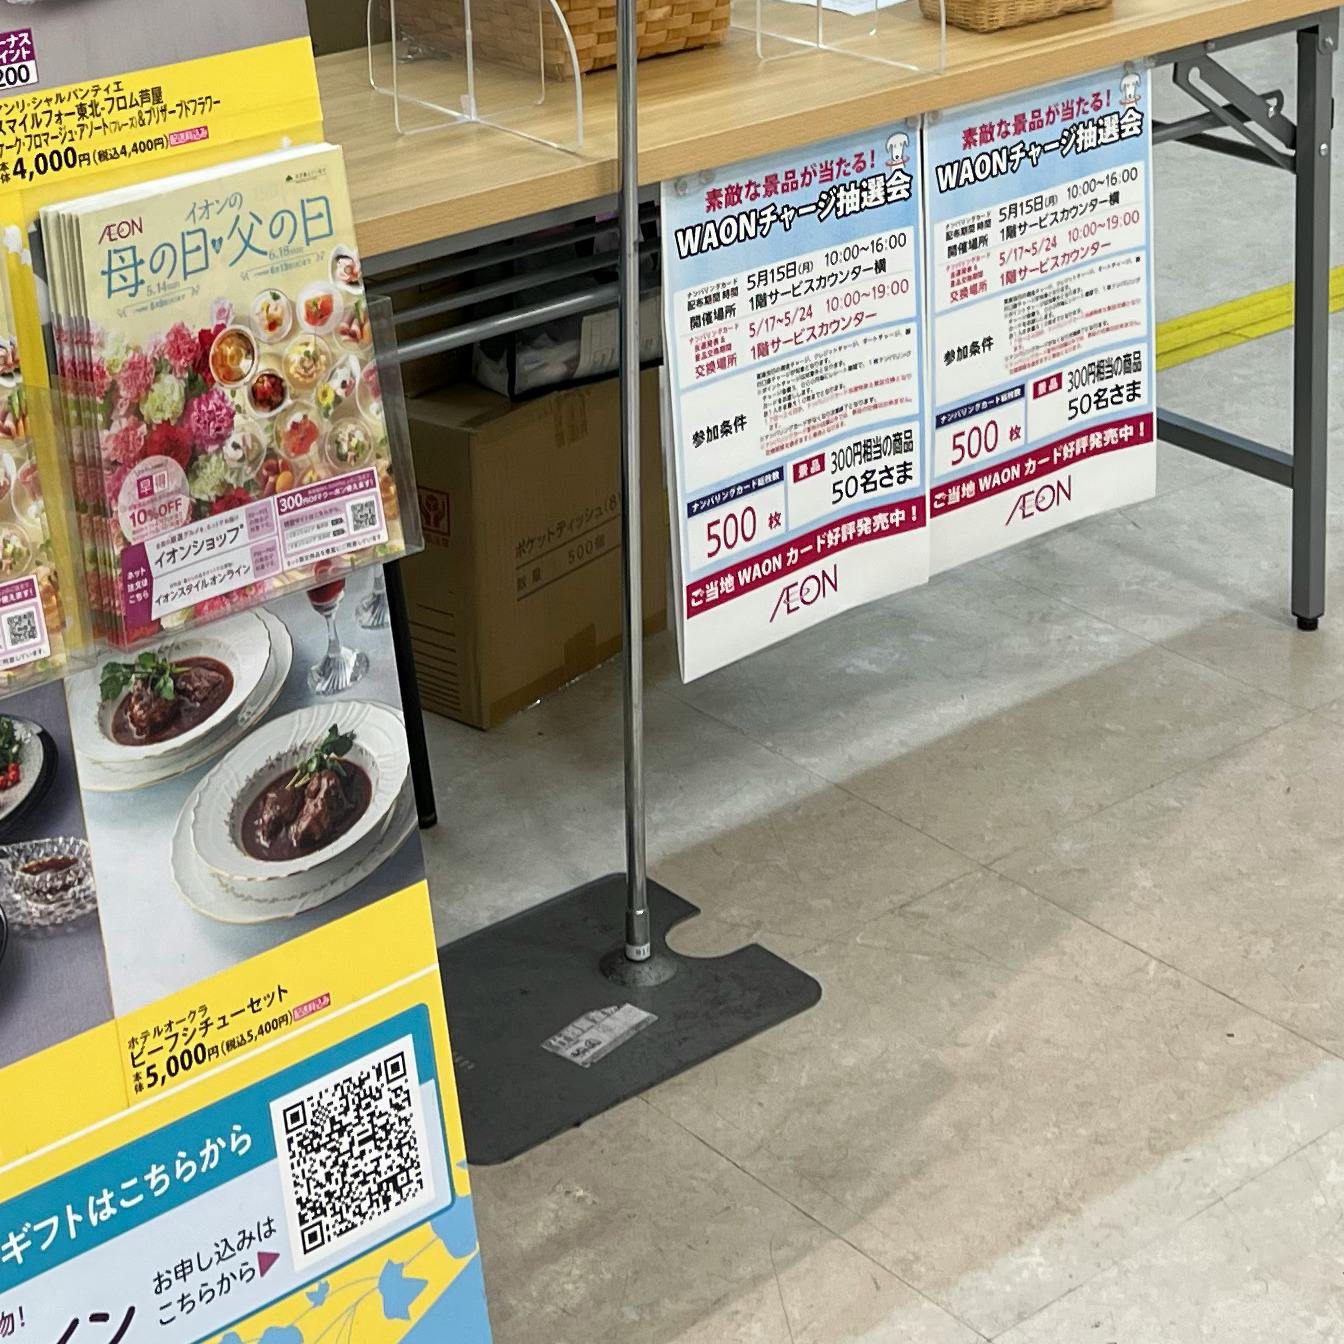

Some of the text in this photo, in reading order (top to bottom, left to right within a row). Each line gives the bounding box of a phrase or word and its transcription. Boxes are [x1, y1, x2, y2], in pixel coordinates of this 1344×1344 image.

[936, 107, 1144, 193] WAONチャージ抽選会
[185, 192, 243, 224] イオンの
[675, 168, 913, 259] WAONチャージ抽選会
[999, 195, 1058, 222] 5月15日(月)
[1000, 191, 1120, 242] 1階サービスカウンター横
[747, 260, 814, 290] 5月15日(月)
[1000, 242, 1111, 287] 1階サービスカウンター
[690, 259, 887, 331] 開催場所 1階サービスカウンター横
[695, 355, 737, 377] 交換場所
[750, 311, 877, 361] 1階サービスカウンター
[1068, 380, 1142, 421] 50名さま
[692, 415, 747, 447] 参加条件
[830, 429, 914, 474] 300円相当の商品
[951, 419, 998, 466] 500
[832, 460, 914, 505] 50名さま
[934, 480, 975, 509] ご当地
[979, 464, 1020, 490] WAON
[129, 501, 183, 526] 10%OFF
[706, 506, 782, 558] 500 枚
[155, 524, 245, 569] イオンショップ
[690, 574, 735, 607] ご当地
[738, 555, 782, 585] WAON
[128, 1004, 209, 1051] ホテルオークラ
[130, 984, 289, 1068] ビーフシチューセット
[151, 1216, 277, 1295] お申し込みは
[157, 1261, 255, 1327] こちらから
